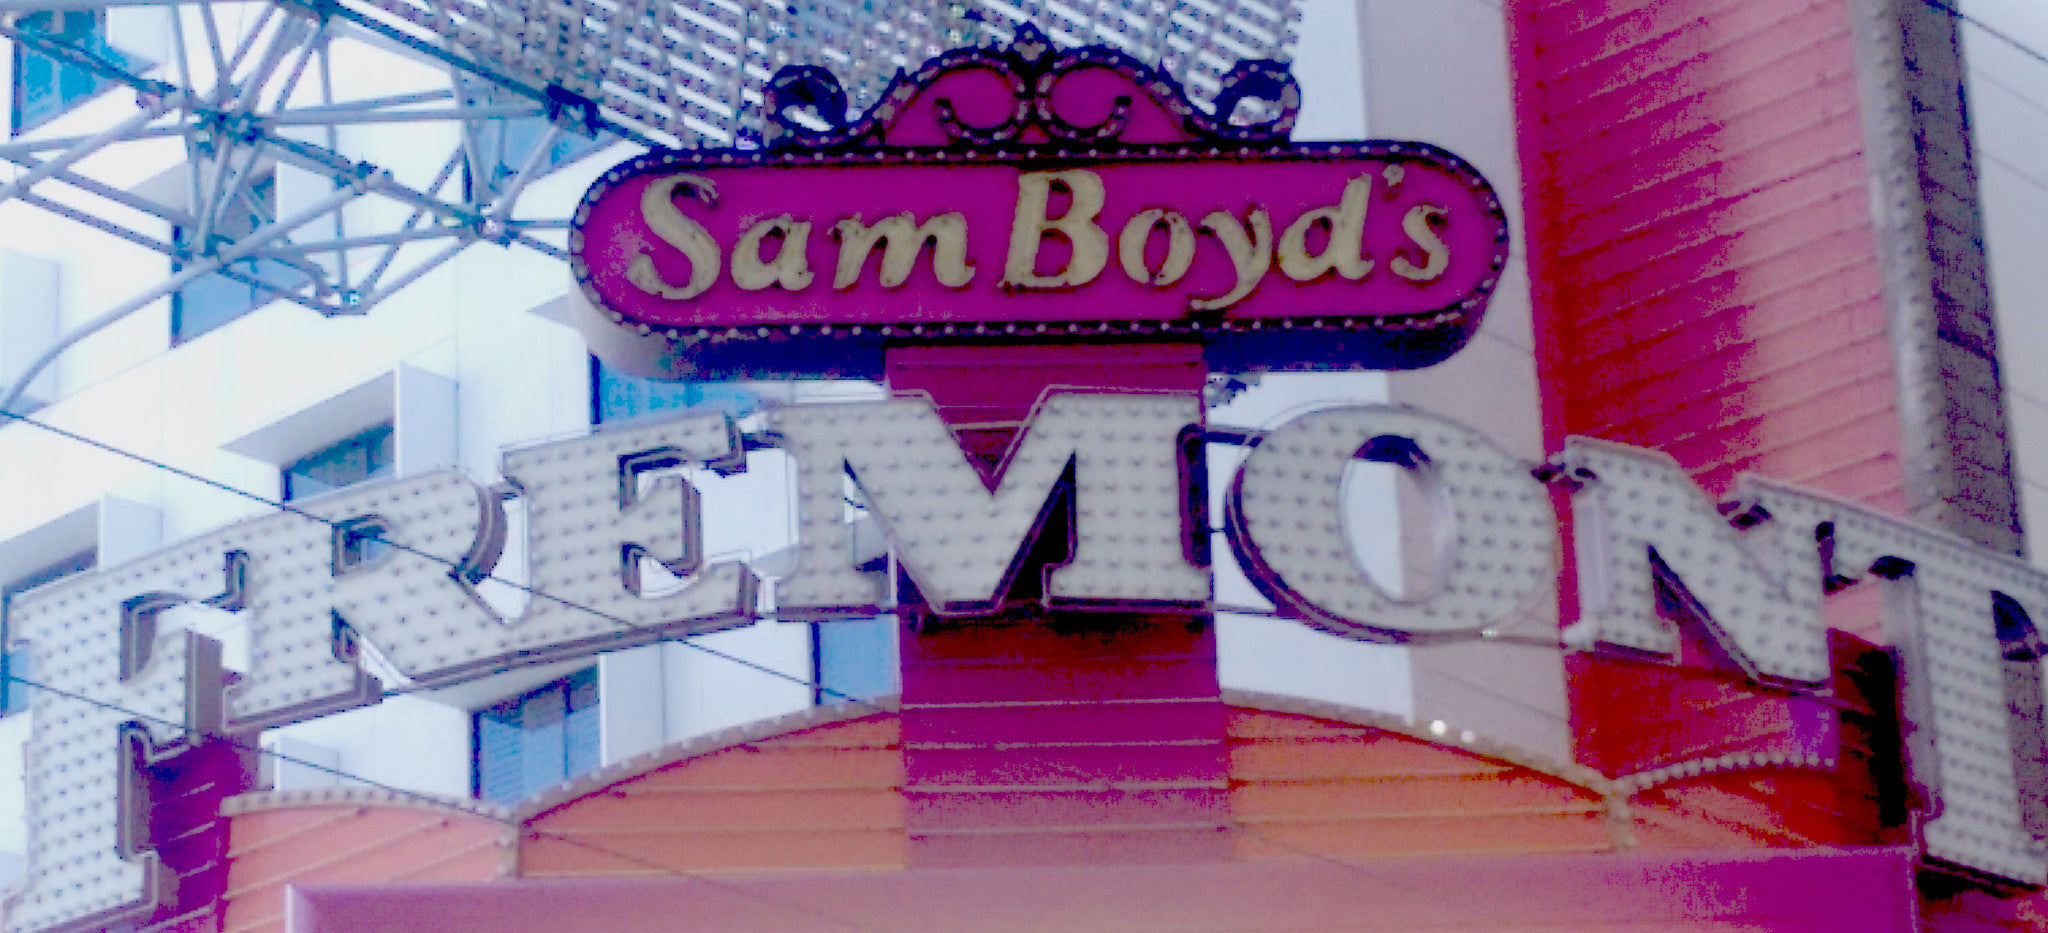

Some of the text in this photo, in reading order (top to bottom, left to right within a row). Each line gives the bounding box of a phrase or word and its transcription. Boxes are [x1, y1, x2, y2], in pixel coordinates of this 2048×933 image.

[625, 166, 1452, 310] Sam Boyd's
[3, 387, 2047, 931] FREMONT
